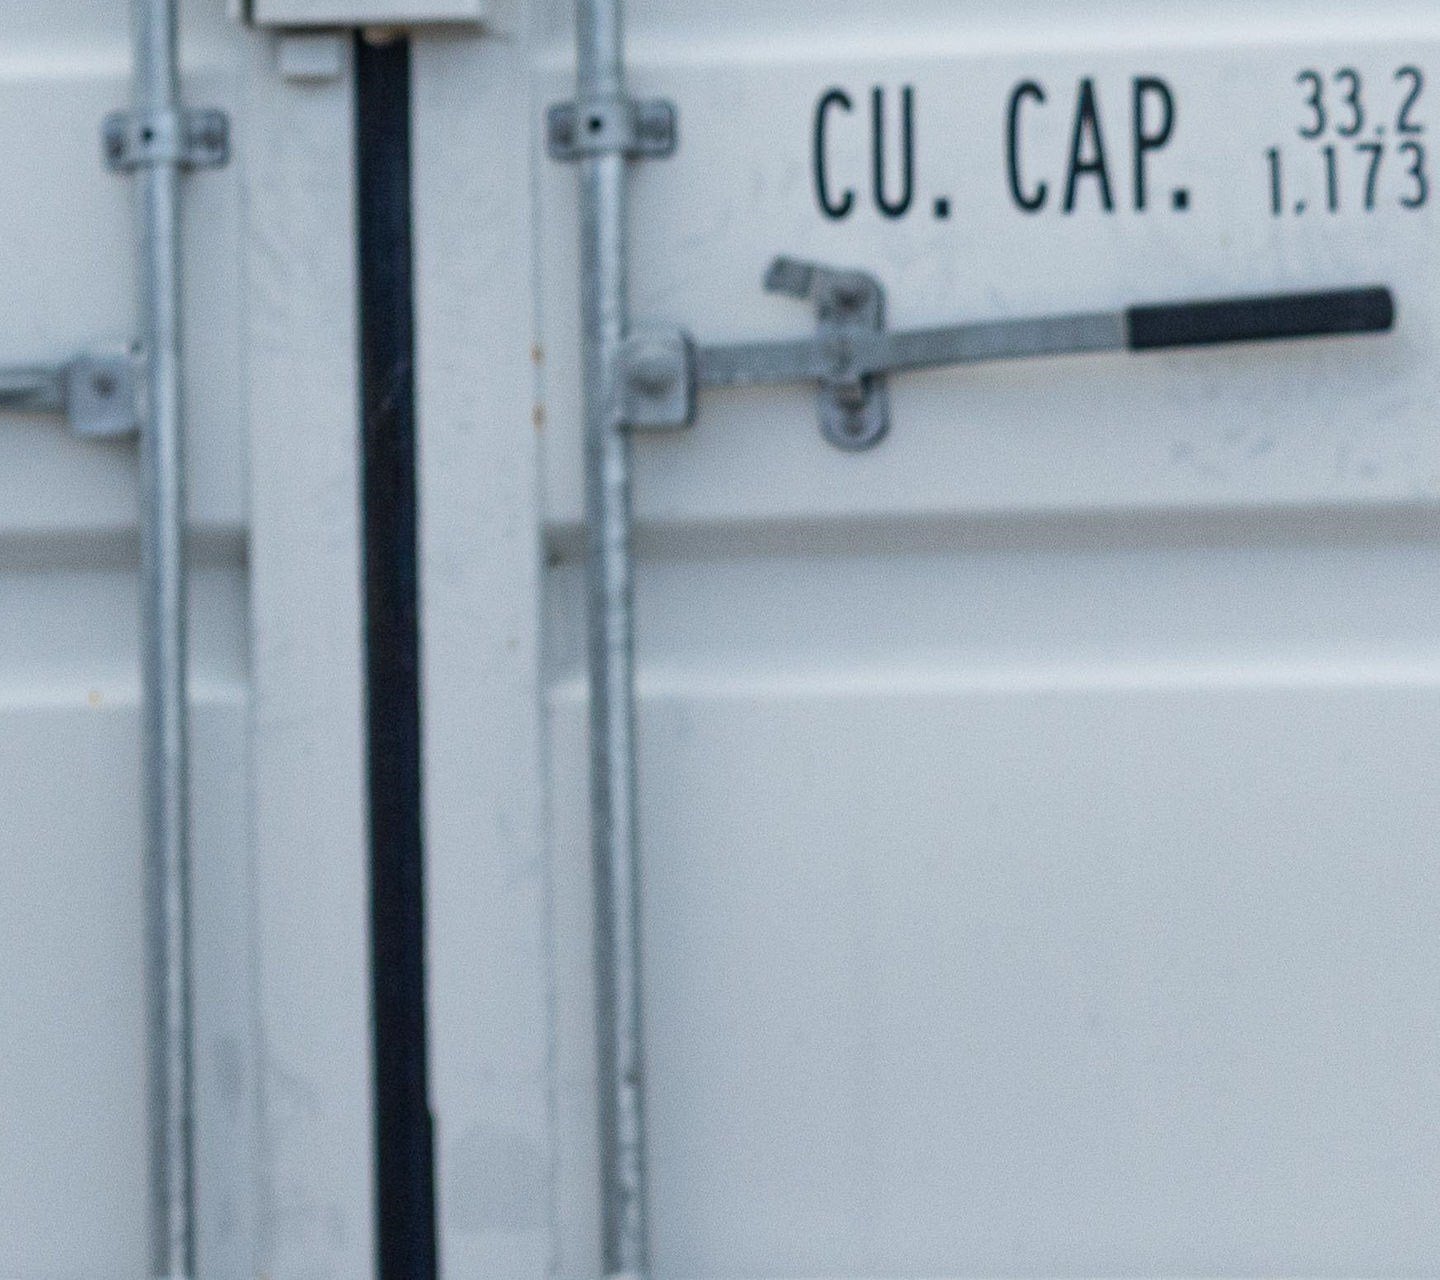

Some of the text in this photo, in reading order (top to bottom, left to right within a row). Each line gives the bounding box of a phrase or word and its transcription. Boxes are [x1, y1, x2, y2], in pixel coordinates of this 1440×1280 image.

[810, 74, 1192, 224] CU. CAP.
[1296, 64, 1425, 139] 33.2
